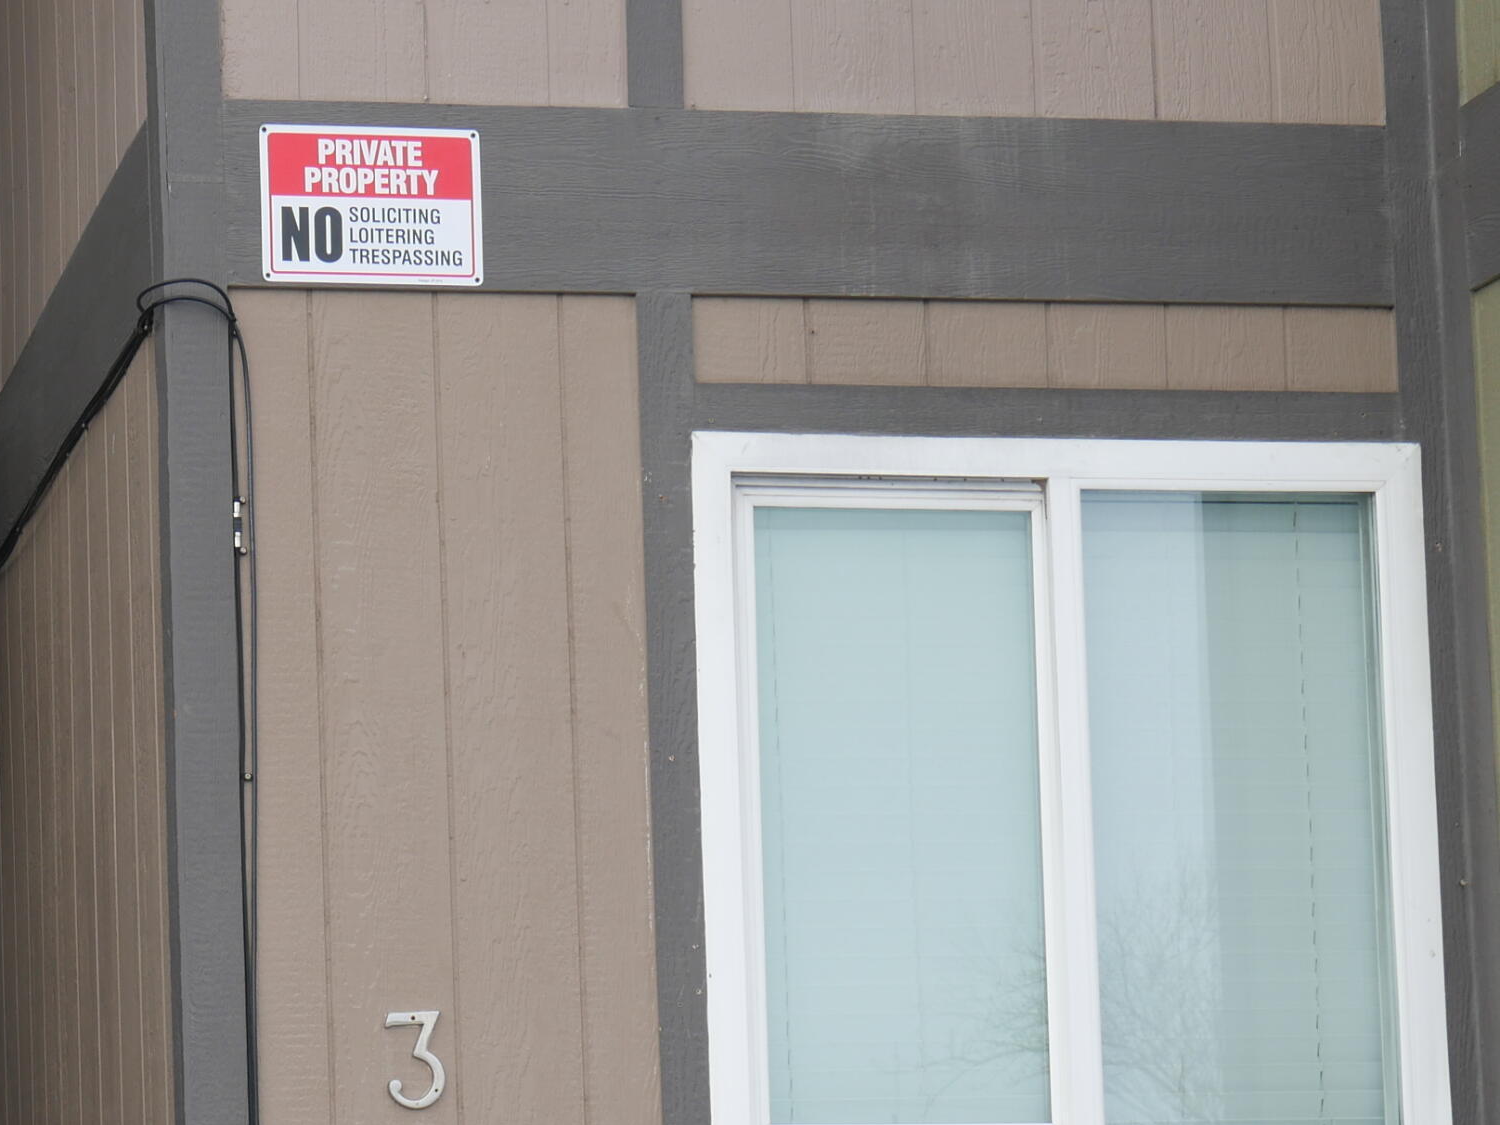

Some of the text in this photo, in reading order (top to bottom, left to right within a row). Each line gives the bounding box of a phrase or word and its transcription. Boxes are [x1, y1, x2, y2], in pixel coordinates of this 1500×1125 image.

[317, 138, 423, 167] PRIVATE
[304, 167, 439, 196] PROPERTY
[349, 206, 441, 225] SOLICITING
[281, 206, 343, 263] NO
[349, 227, 435, 245] LOITERING
[349, 248, 463, 267] TRESPASSING
[385, 1010, 446, 1110] 3
